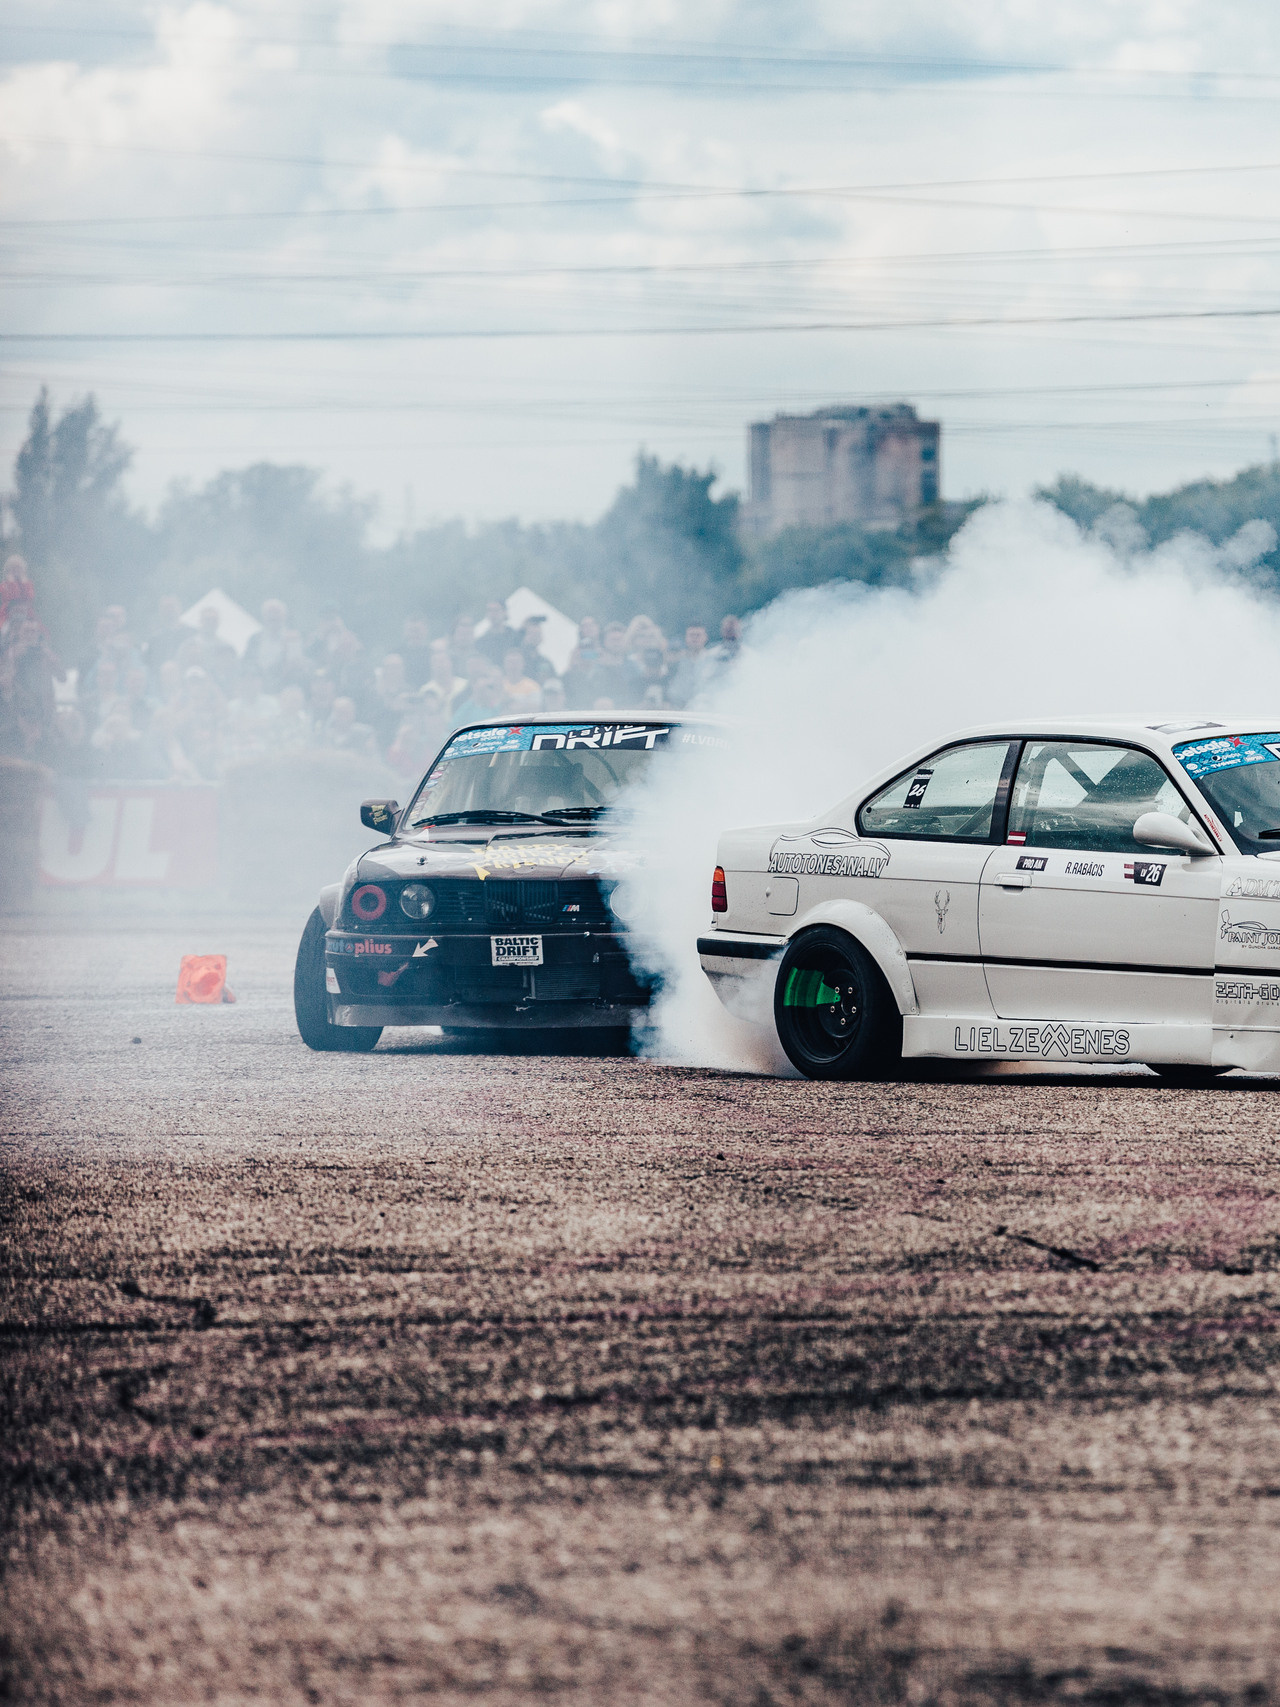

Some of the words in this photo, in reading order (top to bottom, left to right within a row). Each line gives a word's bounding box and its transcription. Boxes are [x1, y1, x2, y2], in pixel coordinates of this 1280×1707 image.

[453, 728, 508, 743] etsafe
[532, 726, 670, 751] DRIFT
[908, 784, 928, 797] 26
[768, 853, 888, 878] AUTOTONESANA.LV
[1145, 864, 1163, 883] 26
[495, 937, 539, 946] BALTIC
[1228, 932, 1261, 943] PAINT
[495, 946, 539, 956] DRIFT
